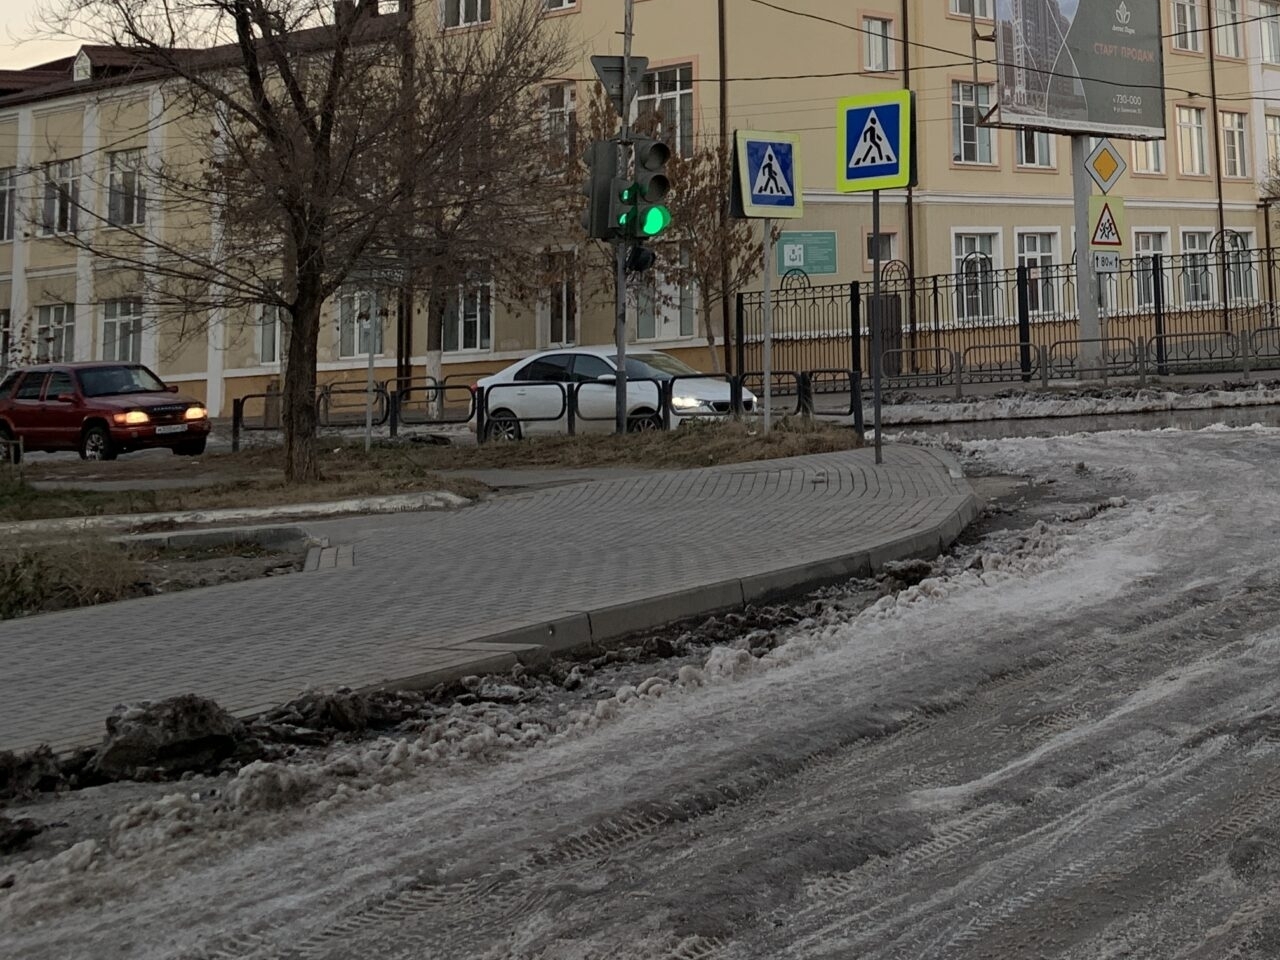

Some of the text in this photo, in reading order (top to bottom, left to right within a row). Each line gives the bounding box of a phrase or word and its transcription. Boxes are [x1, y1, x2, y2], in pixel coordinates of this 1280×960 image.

[1094, 42, 1155, 63] СТАРТ ПРОДАЖ
[1116, 94, 1142, 105] 730-000
